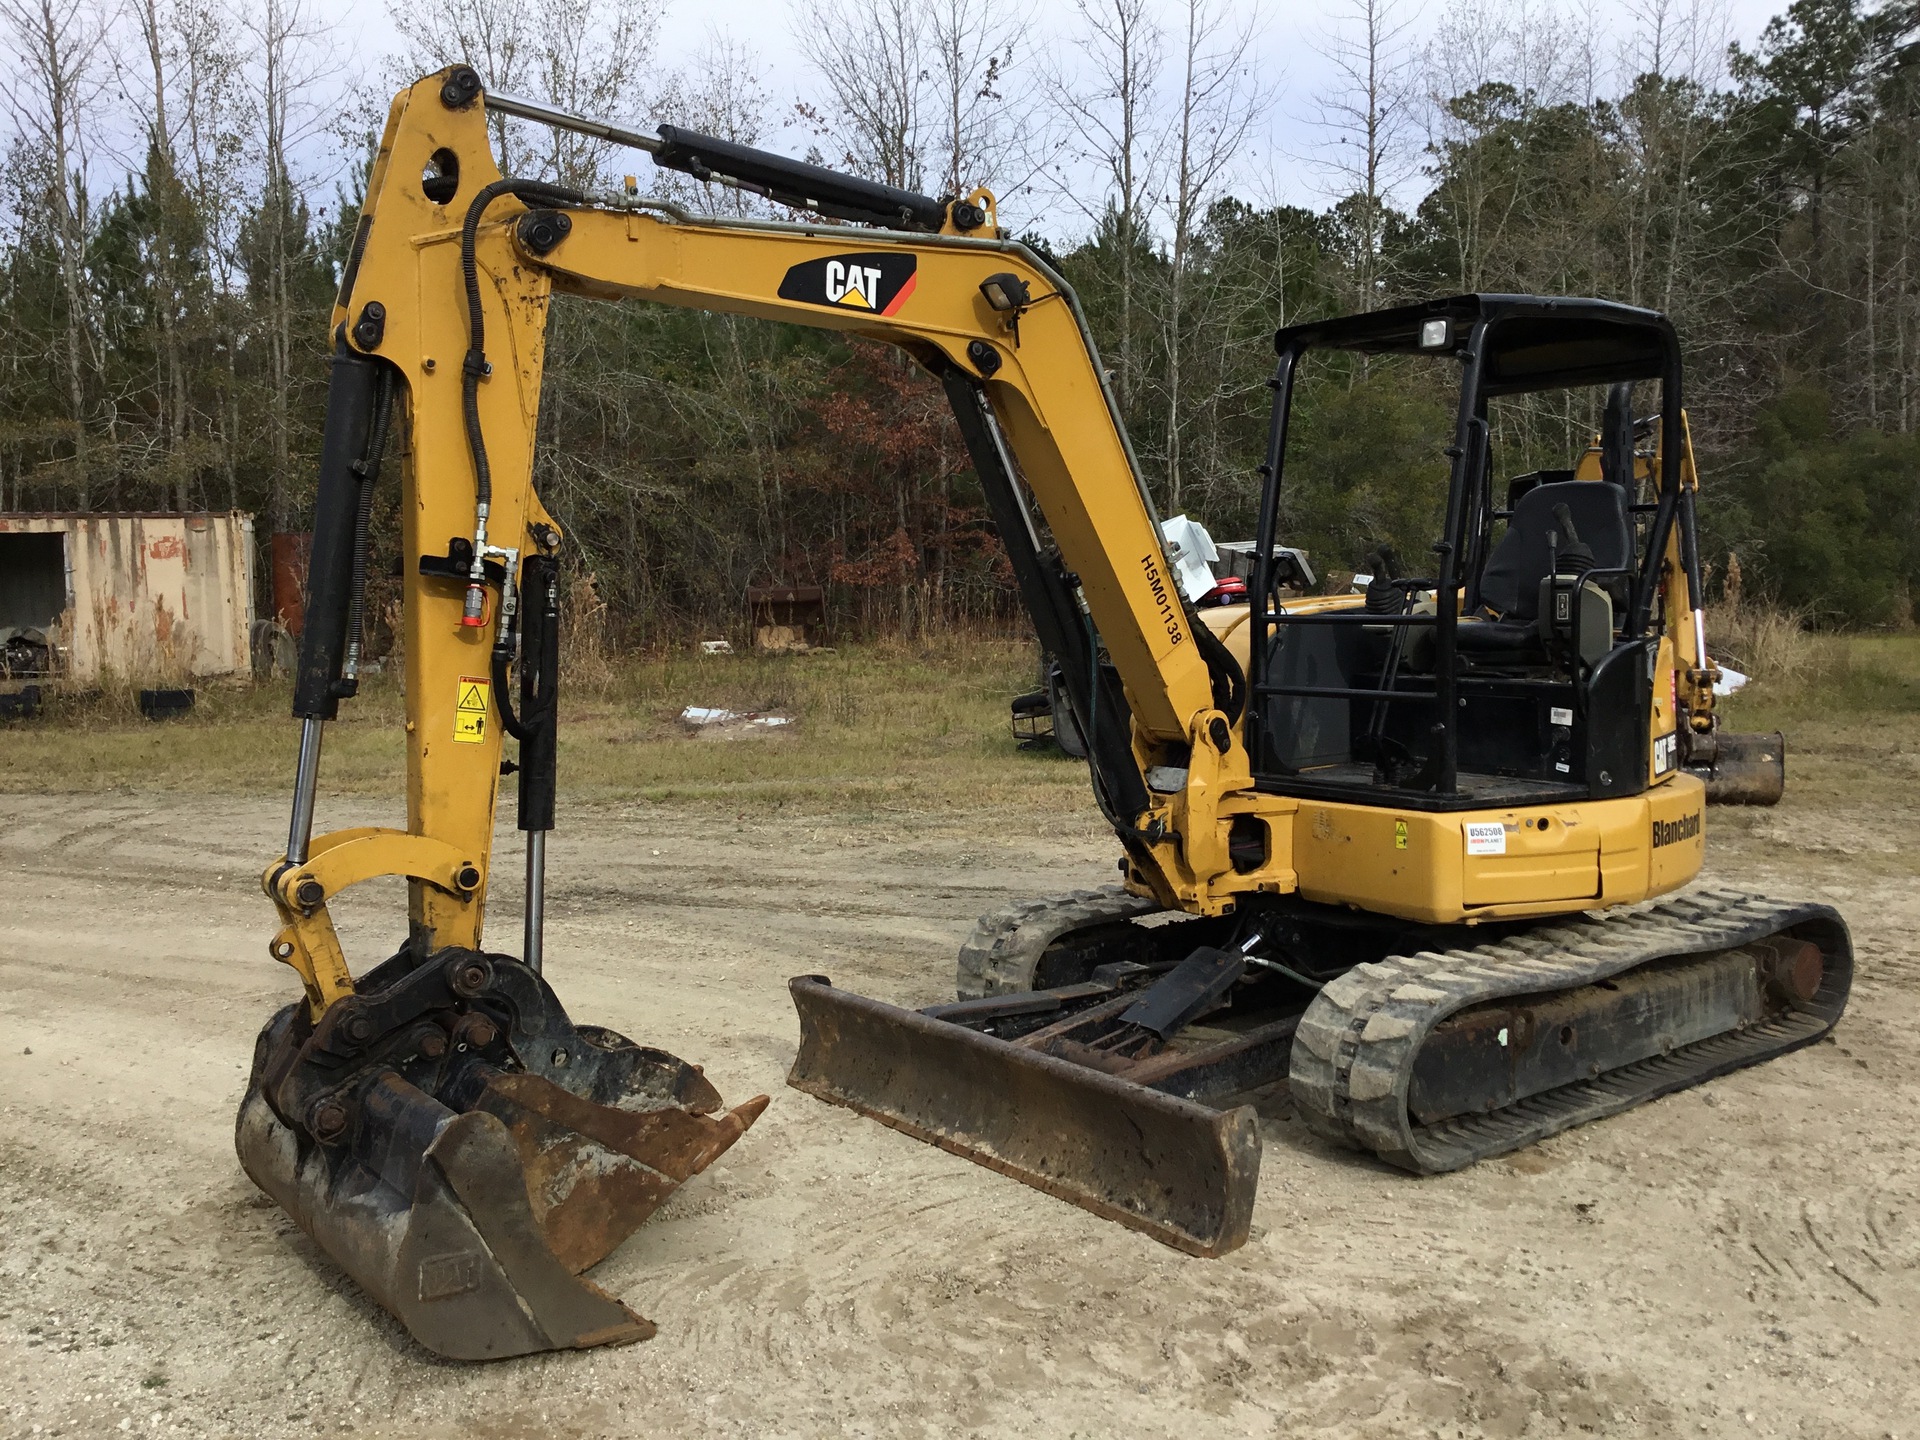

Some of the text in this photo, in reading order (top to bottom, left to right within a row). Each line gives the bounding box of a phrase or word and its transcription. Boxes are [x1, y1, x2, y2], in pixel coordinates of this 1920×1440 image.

[825, 260, 882, 309] CAT
[1141, 554, 1182, 645] H5M01138
[1470, 827, 1503, 837] U562508
[1652, 807, 1701, 849] Blanchard
